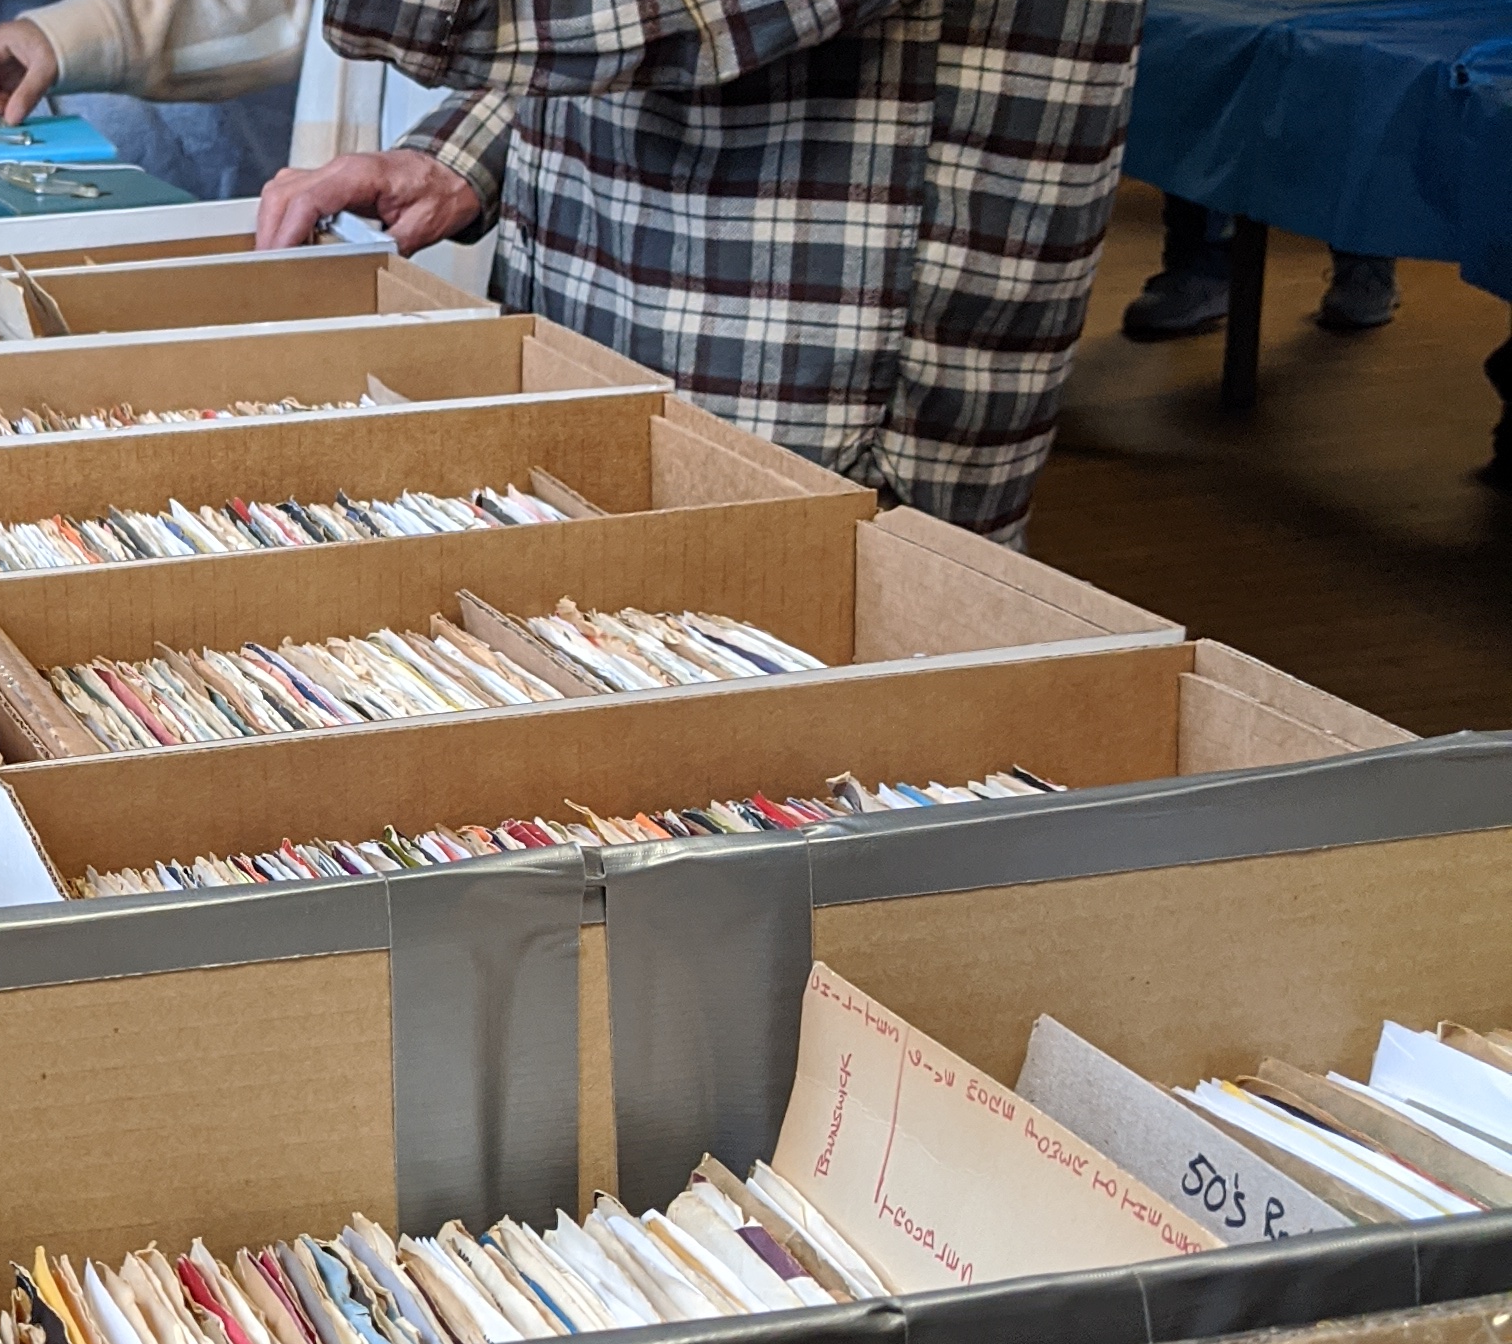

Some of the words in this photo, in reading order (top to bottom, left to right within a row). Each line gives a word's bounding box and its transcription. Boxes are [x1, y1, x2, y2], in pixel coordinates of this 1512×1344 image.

[966, 1078, 1016, 1121] MORE
[1024, 1117, 1090, 1176] POWER
[1092, 1170, 1117, 1198] TO
[1120, 1188, 1163, 1227] THE
